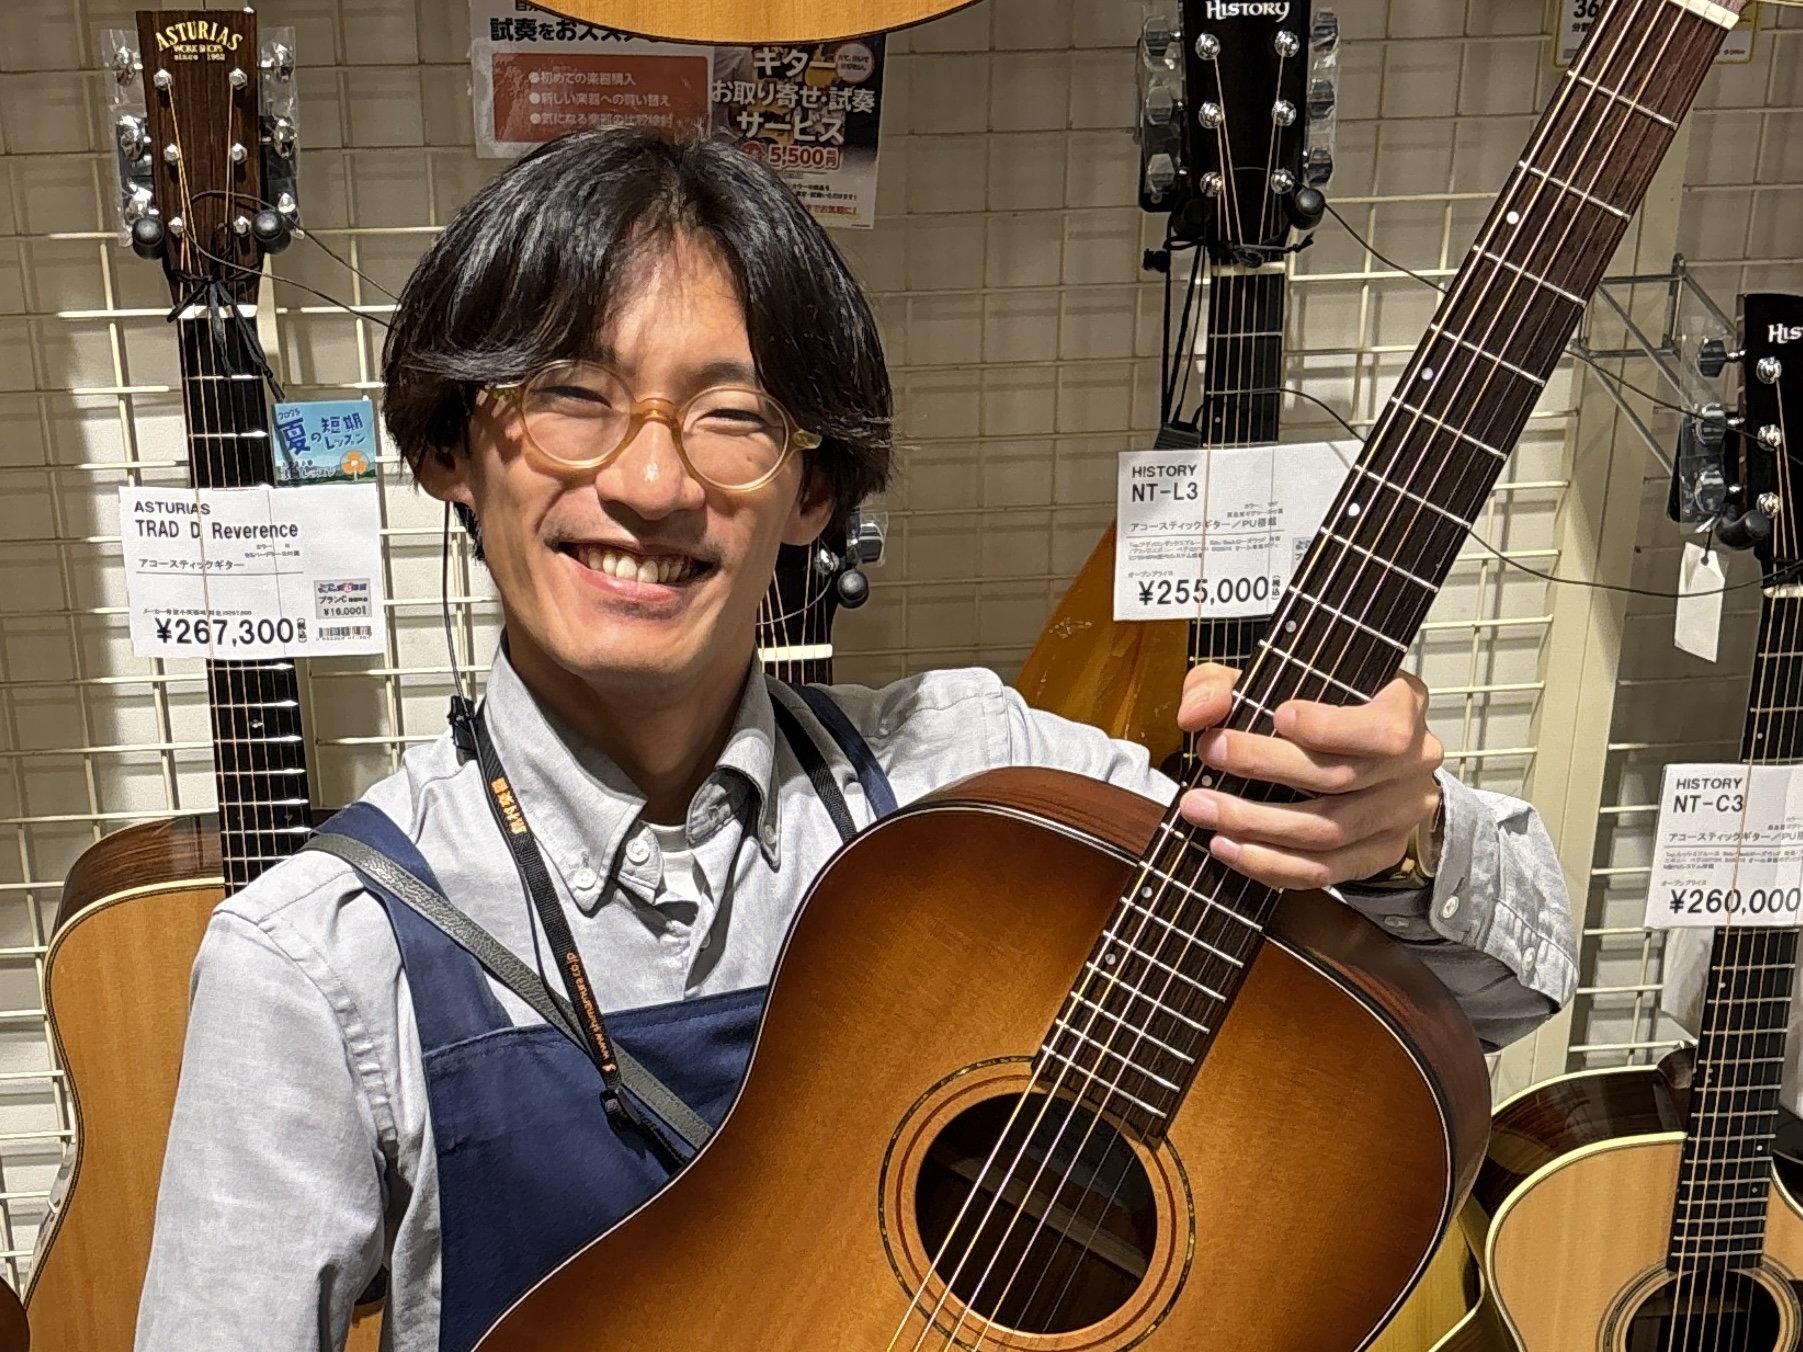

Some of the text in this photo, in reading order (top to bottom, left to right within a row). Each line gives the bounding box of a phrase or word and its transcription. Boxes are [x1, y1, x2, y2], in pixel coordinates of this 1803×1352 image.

[155, 20, 243, 52] ASTURIAS
[753, 46, 837, 77] ギター
[737, 110, 845, 144] サービス
[1768, 323, 1803, 344] HIS
[1132, 465, 1197, 478] HISTORY
[1132, 482, 1198, 502] NT-L3
[134, 501, 210, 515] ASTURIAS
[136, 519, 299, 540] TRAD D Reverence
[138, 557, 246, 570] アコースティックギター
[1139, 576, 1269, 605] ¥255,000
[155, 617, 294, 647] ¥267,300
[1676, 778, 1743, 790] HISTORY
[1673, 794, 1744, 813] NT-C3
[1669, 888, 1801, 914] ¥260,000
